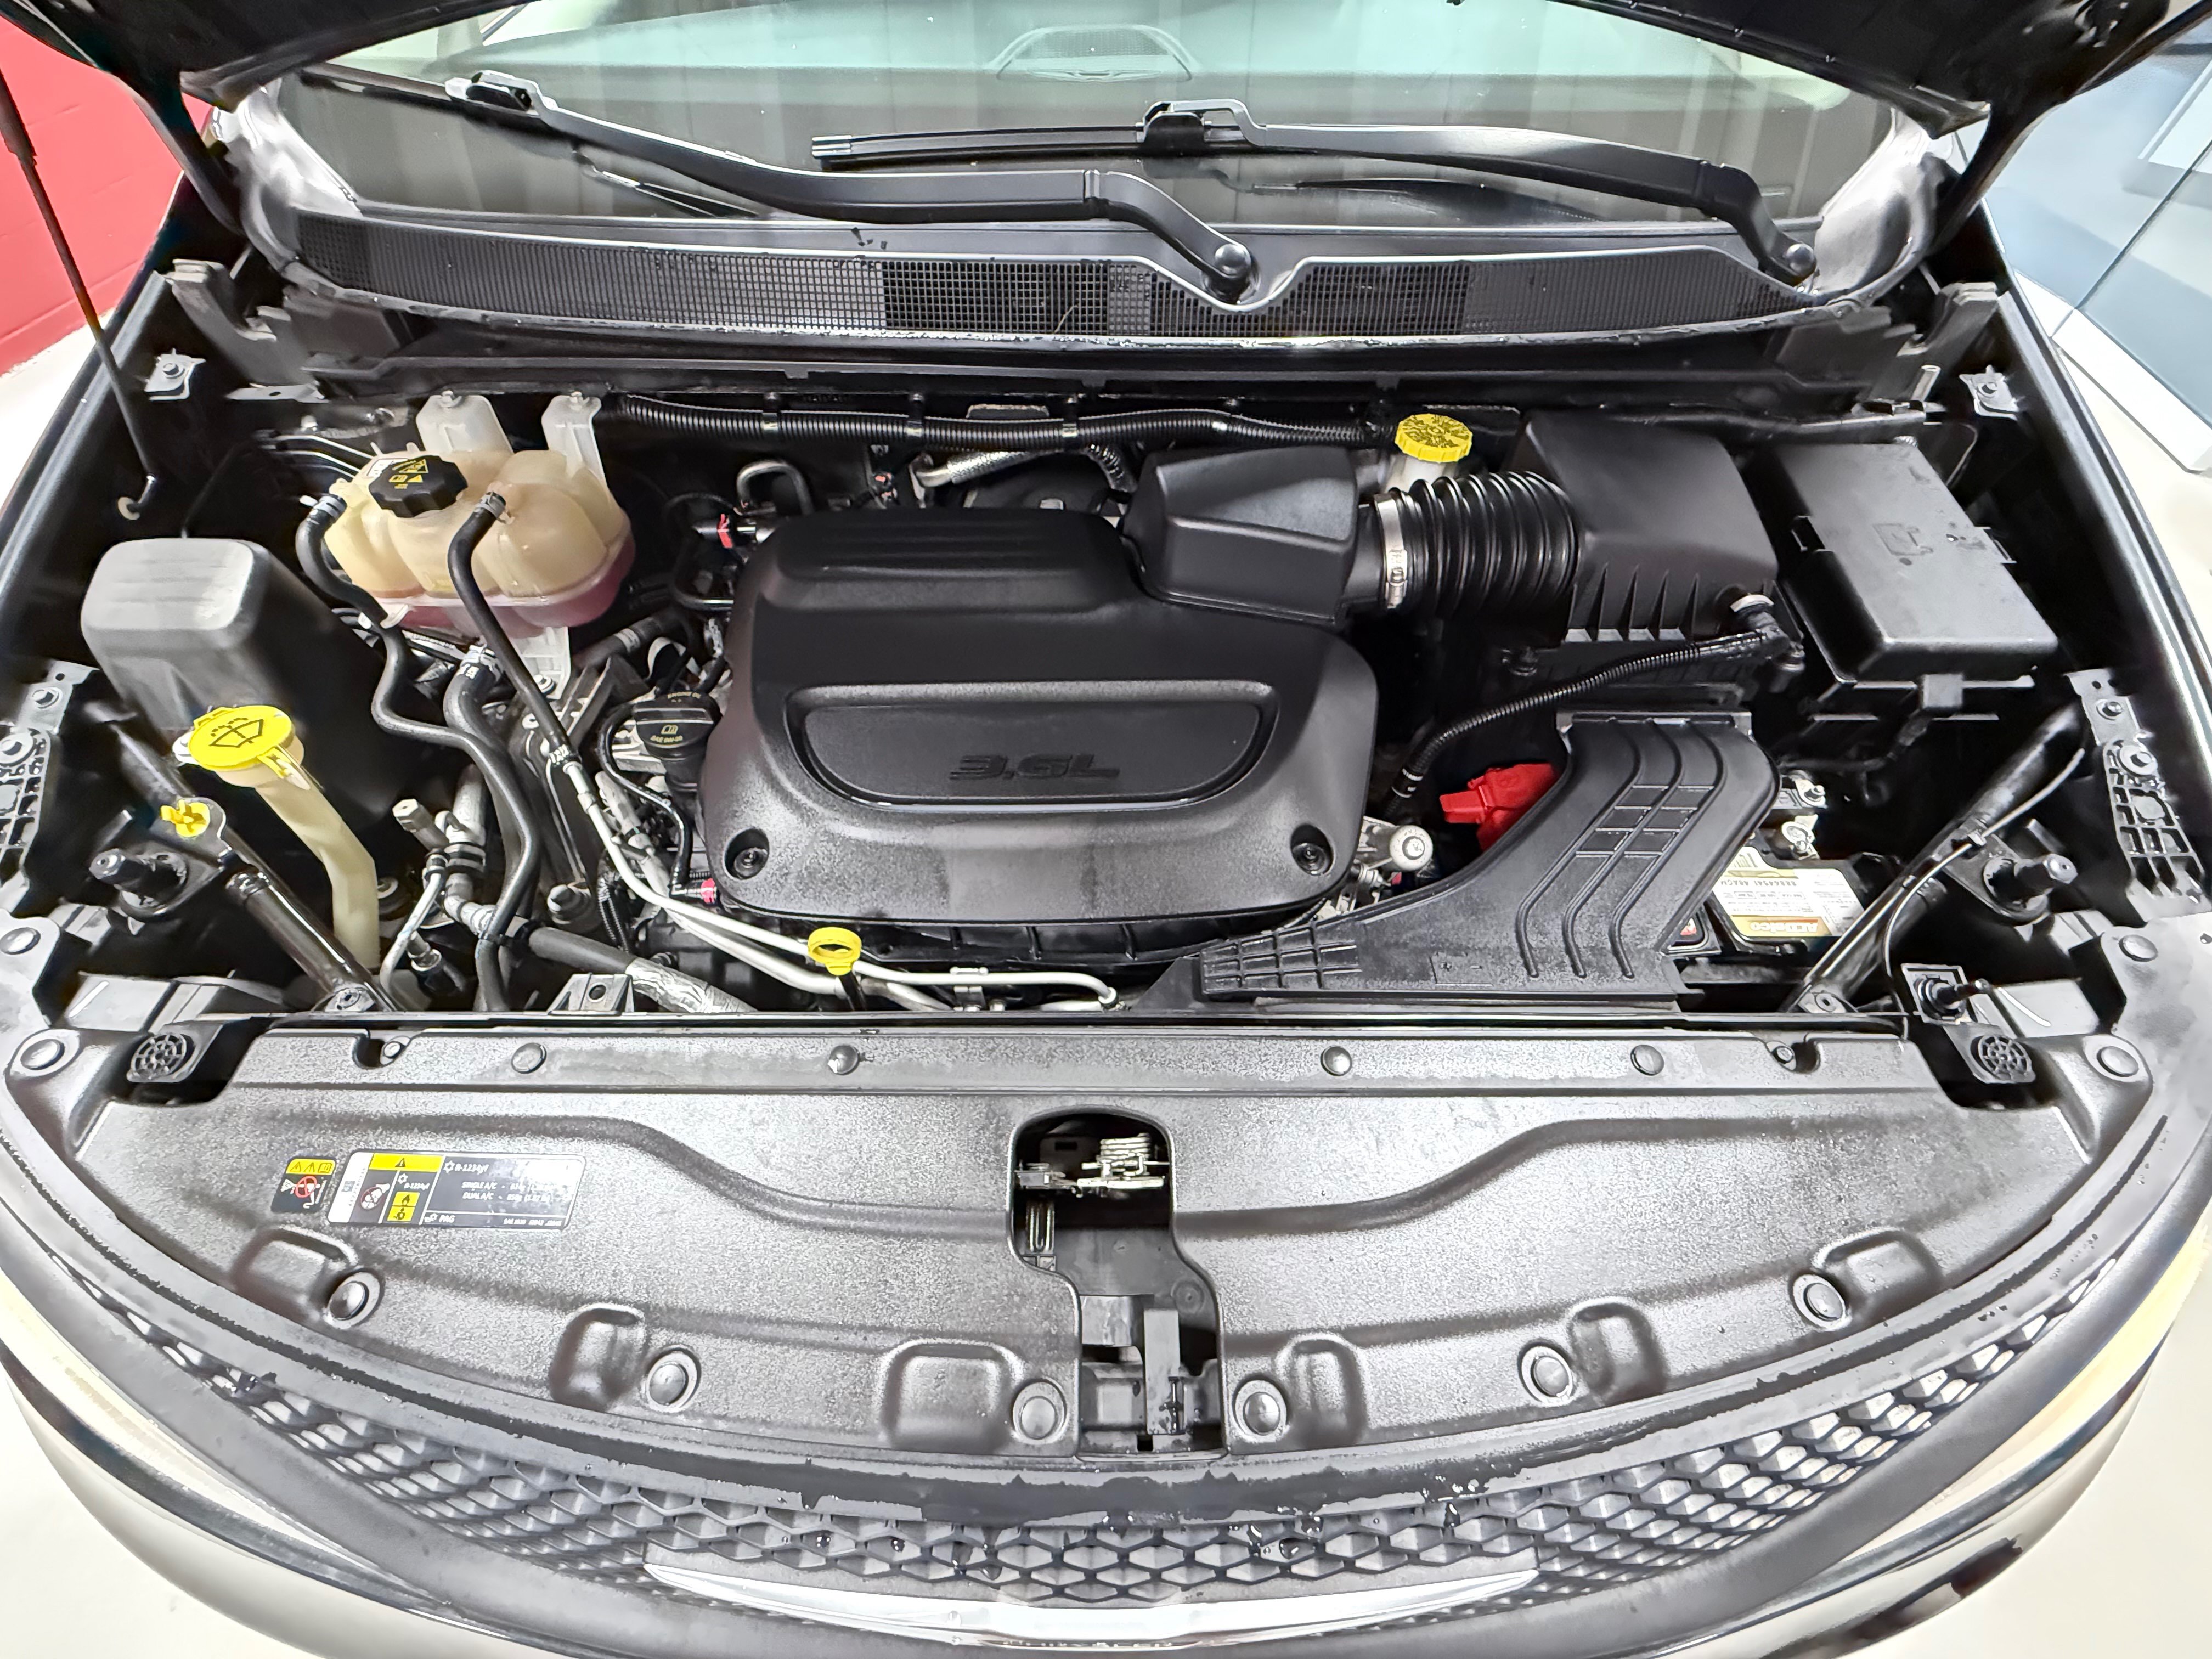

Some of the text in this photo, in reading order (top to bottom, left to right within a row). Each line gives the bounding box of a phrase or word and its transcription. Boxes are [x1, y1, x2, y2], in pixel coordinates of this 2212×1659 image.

[949, 754, 1121, 781] 3.6L
[1749, 922, 1818, 933] ACDelco
[438, 1215, 456, 1223] PAG
